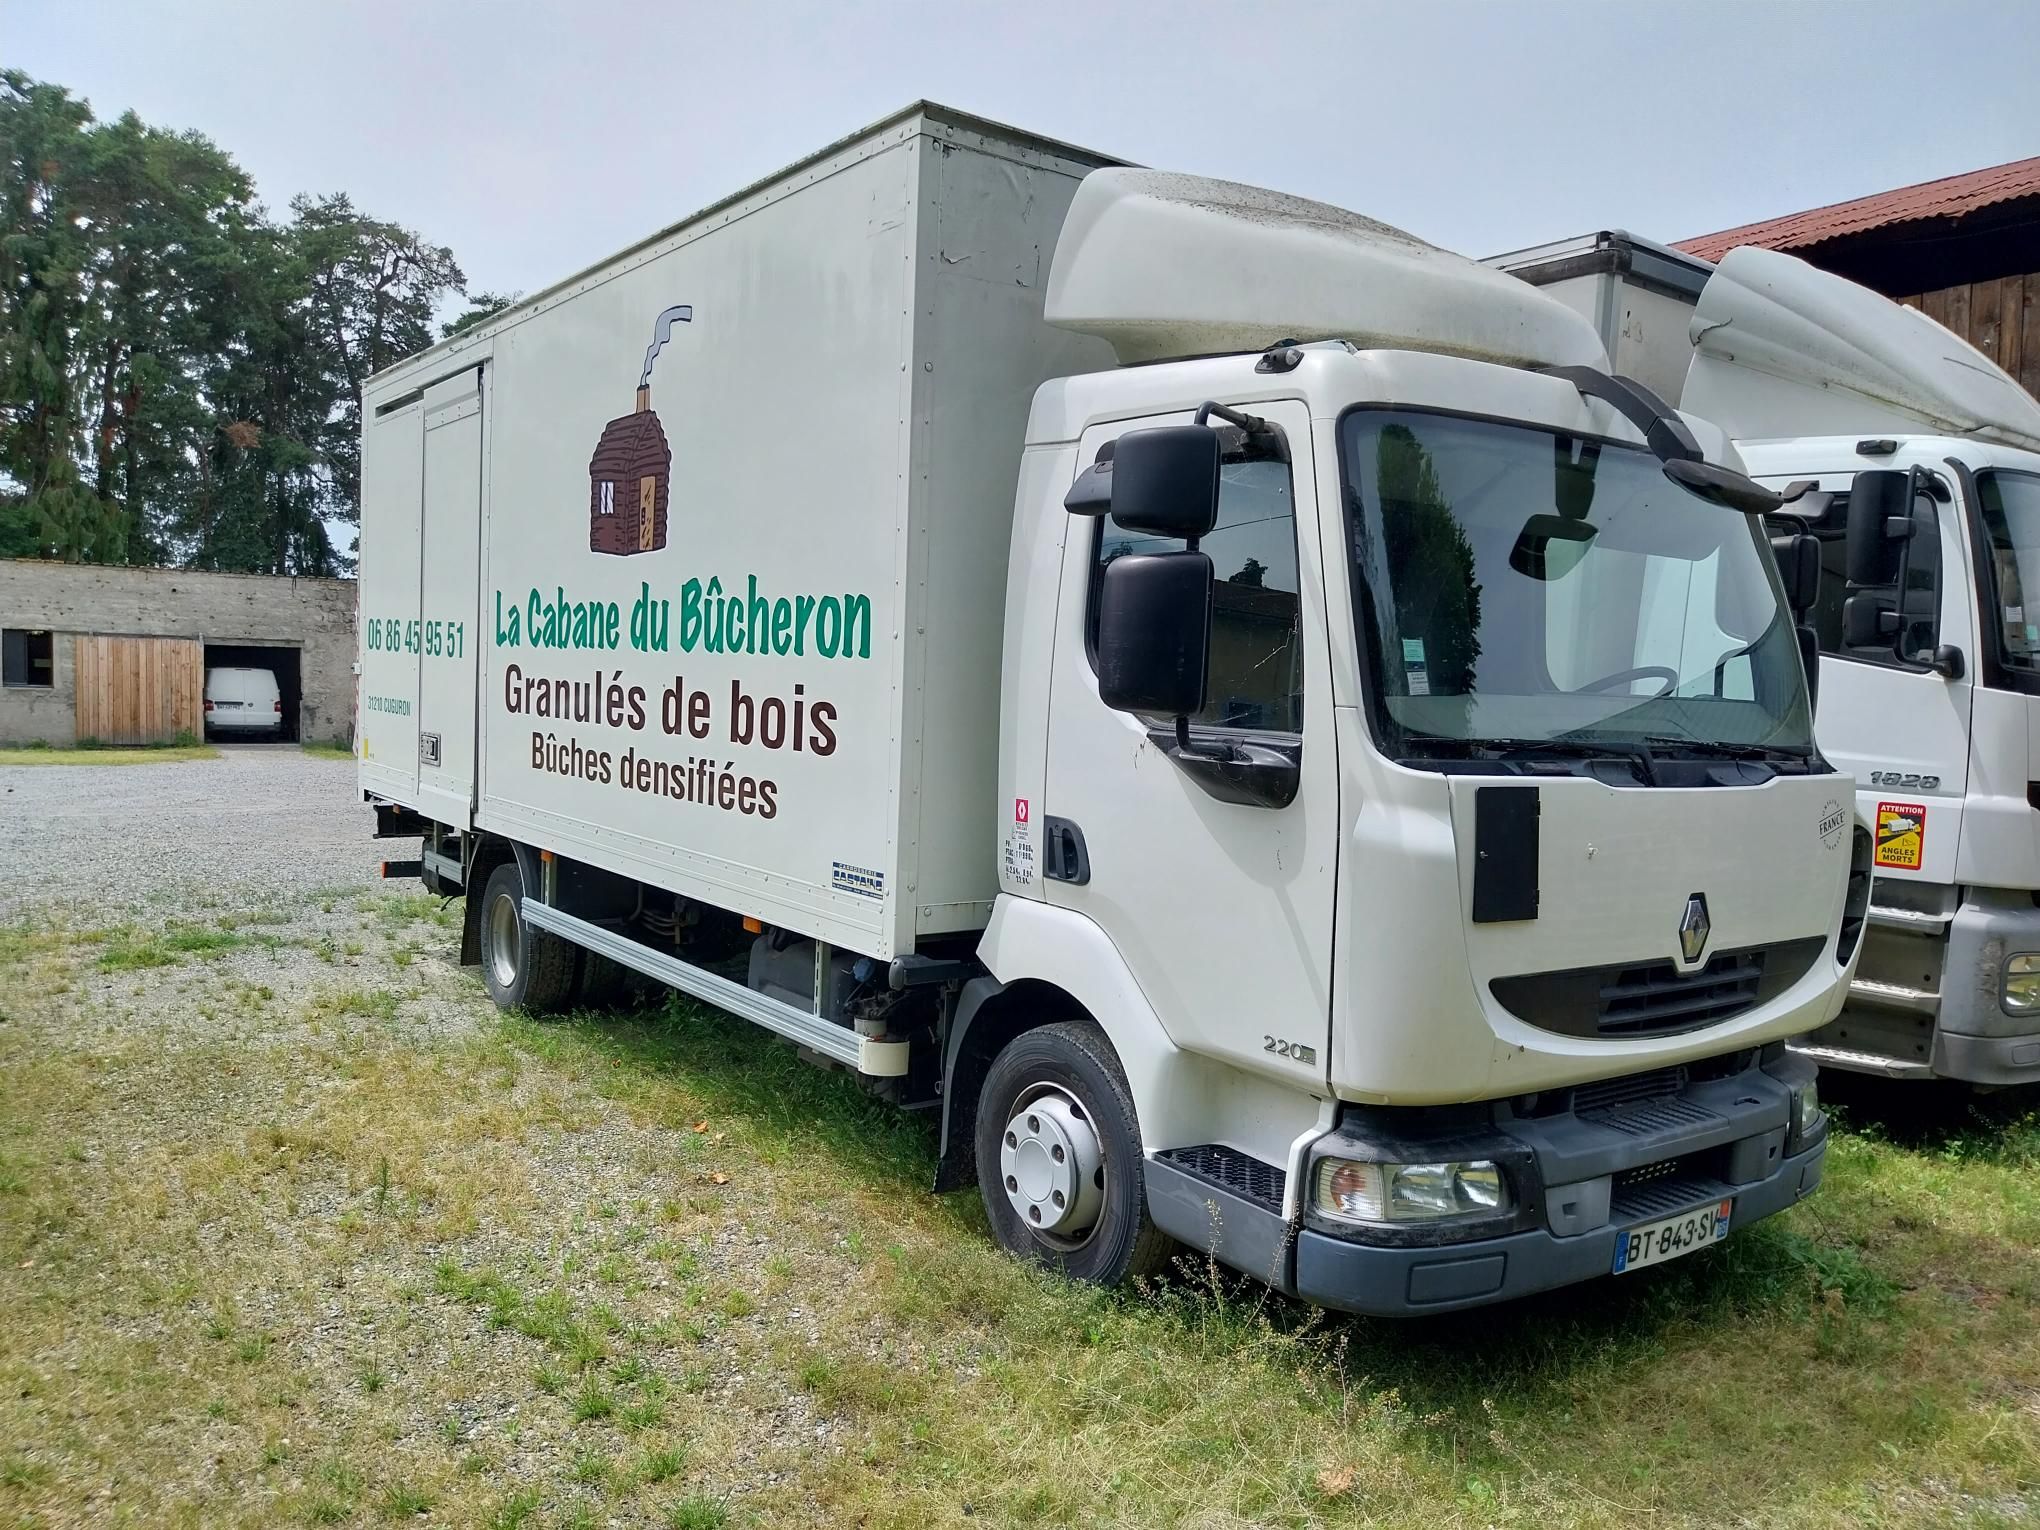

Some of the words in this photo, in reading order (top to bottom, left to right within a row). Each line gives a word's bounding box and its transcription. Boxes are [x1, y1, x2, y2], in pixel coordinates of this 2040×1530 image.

[496, 590, 521, 648] La
[528, 586, 620, 650] Cabane
[630, 581, 669, 653] du
[680, 574, 871, 659] Bûcheron
[368, 619, 382, 650] 06
[386, 619, 401, 652] 86
[405, 620, 420, 654] 45
[426, 621, 442, 656] 95
[447, 622, 464, 658] 51
[506, 664, 647, 730] Granulés
[662, 676, 711, 739] de
[730, 680, 838, 756] bois
[532, 732, 612, 785] Bûches
[620, 747, 778, 820] densifiées
[1819, 811, 1844, 835] FRANCE
[1880, 804, 1924, 814] ATTENTION
[1881, 847, 1915, 856] ANGLES
[1882, 854, 1913, 864] MORTS
[1263, 1035, 1302, 1061] 220
[1627, 1208, 1720, 1263] BT-843-SV
